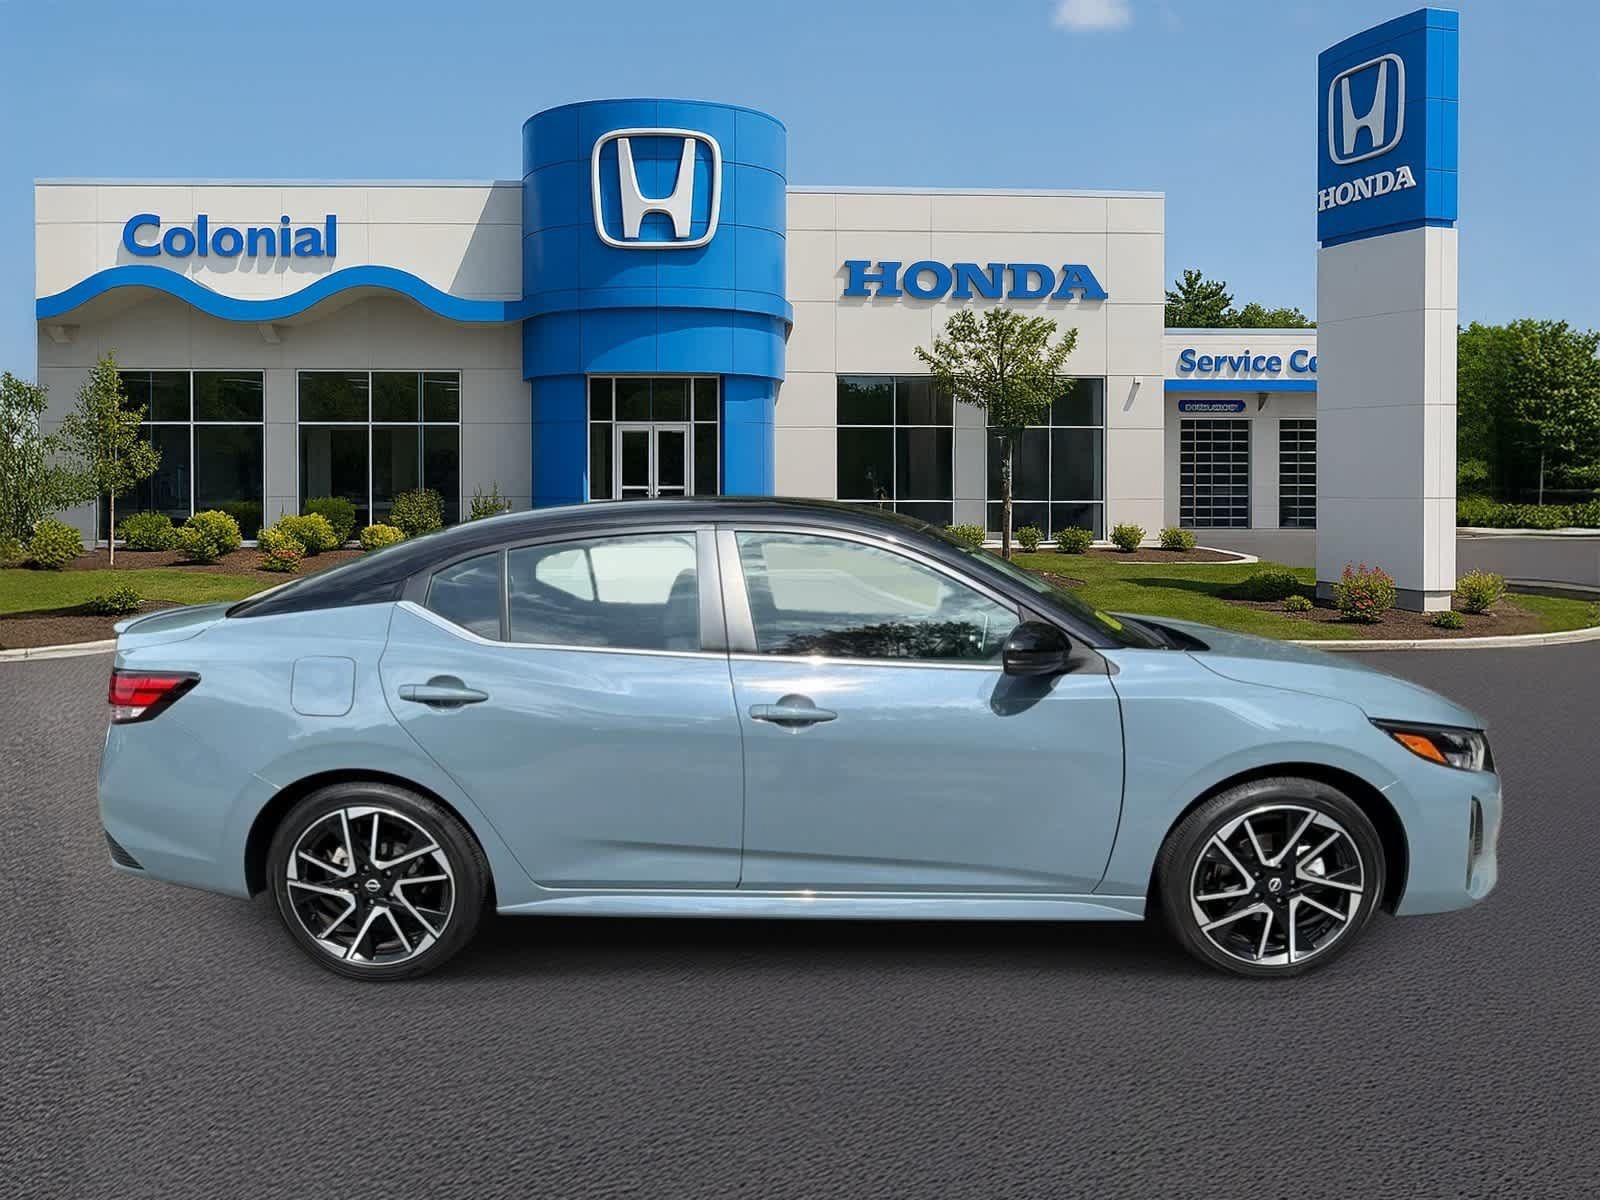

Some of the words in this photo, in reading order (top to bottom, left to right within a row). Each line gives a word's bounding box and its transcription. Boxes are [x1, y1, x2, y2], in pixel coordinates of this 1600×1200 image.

[1318, 165, 1416, 211] HONDA
[122, 213, 337, 257] Colonial
[843, 260, 1108, 300] HONDA
[1180, 348, 1282, 372] Service
